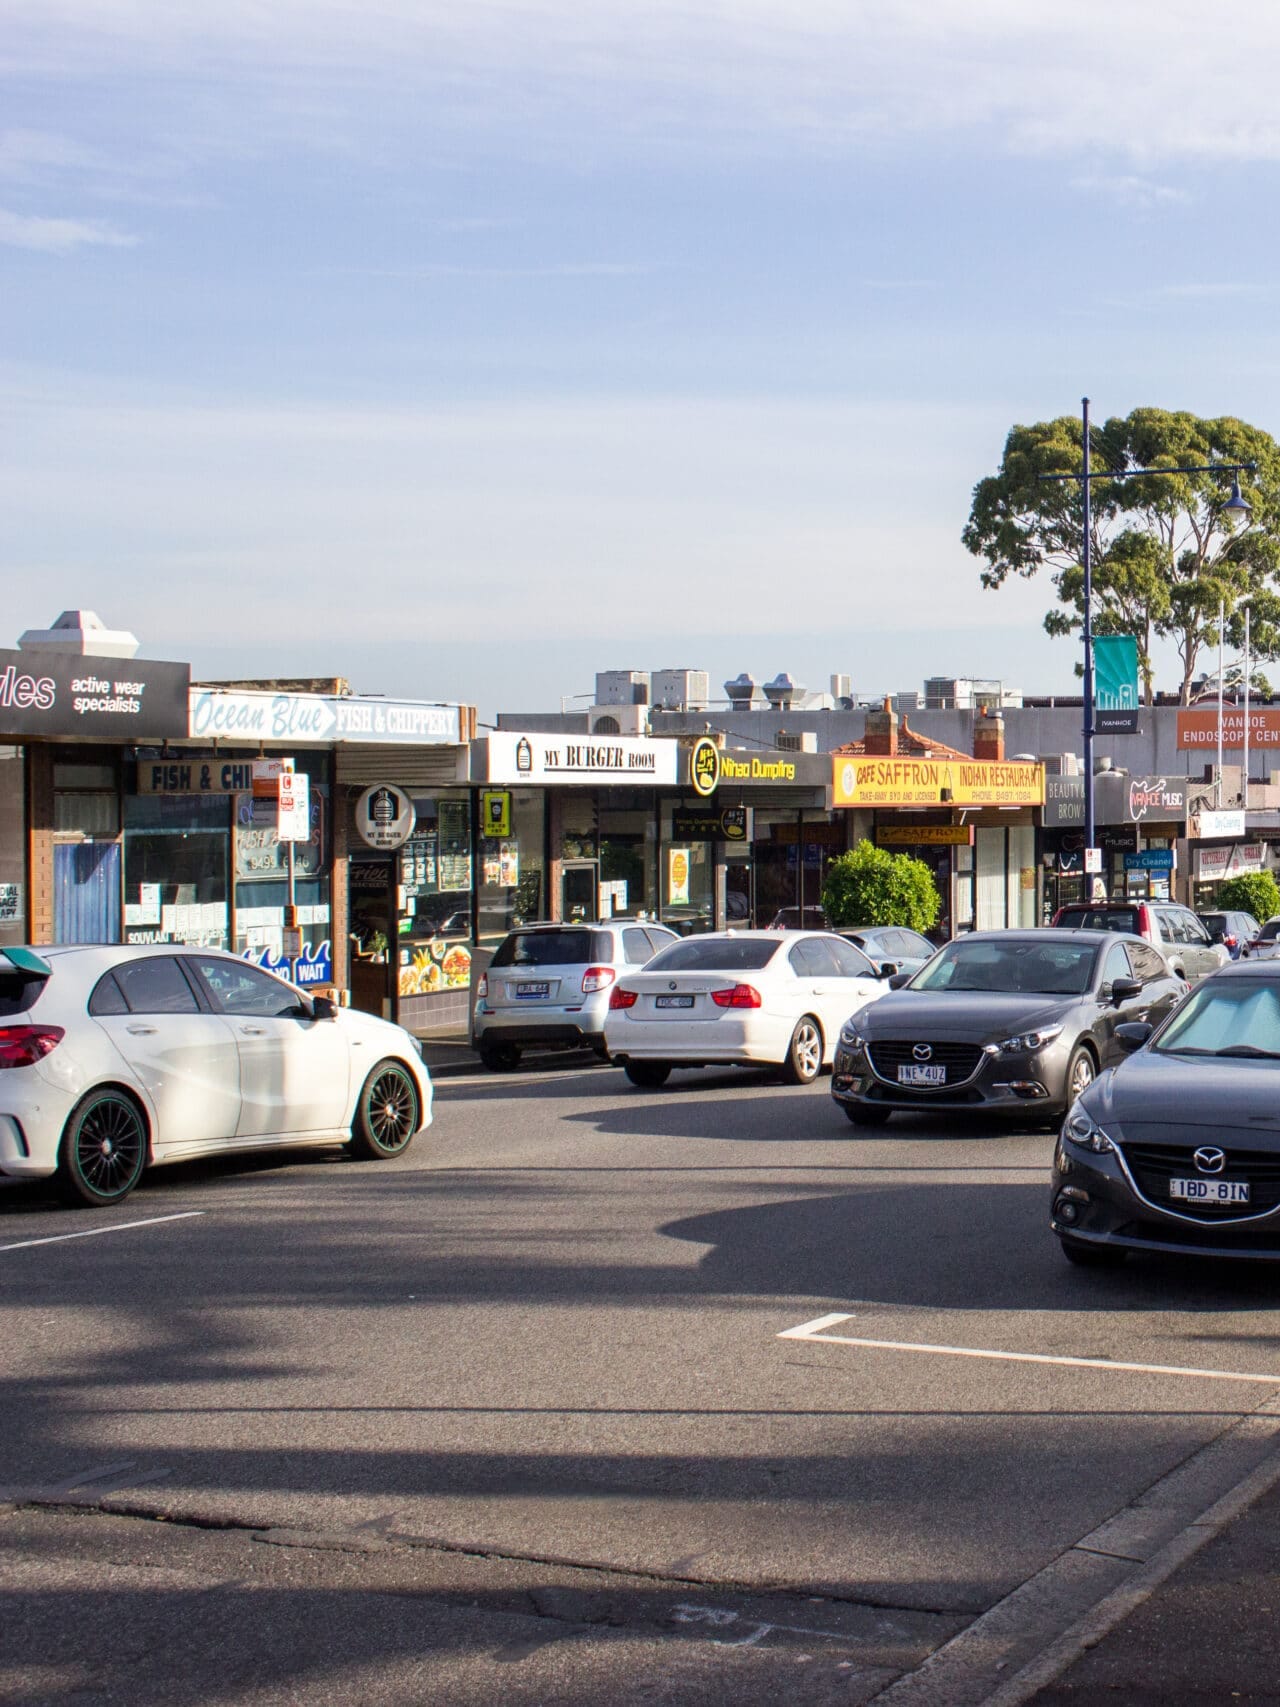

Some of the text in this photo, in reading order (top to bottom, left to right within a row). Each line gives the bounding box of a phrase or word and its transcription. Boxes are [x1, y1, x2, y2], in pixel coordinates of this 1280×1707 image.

[71, 677, 145, 696] active wear
[73, 696, 140, 714] specialists
[193, 692, 324, 736] Ocean Blue
[335, 705, 372, 733] FISH
[387, 707, 455, 736] CHIPPERY
[1101, 719, 1132, 727] IVANHOE
[544, 745, 655, 768] MY BURGER ROOM
[721, 757, 750, 778] Nihao
[856, 762, 938, 786] CAFE SAFFRON
[959, 765, 1041, 788] INDIAN RESTAURANT
[152, 764, 192, 791] FISH
[200, 764, 211, 790] &
[221, 764, 252, 790] CHI
[1049, 783, 1079, 799] BEAUTY
[1131, 792, 1183, 806] IVANHOE MUSIC
[1058, 803, 1080, 819] BROW
[1125, 856, 1171, 868] Dry Cleaner
[298, 963, 325, 982] WAIT
